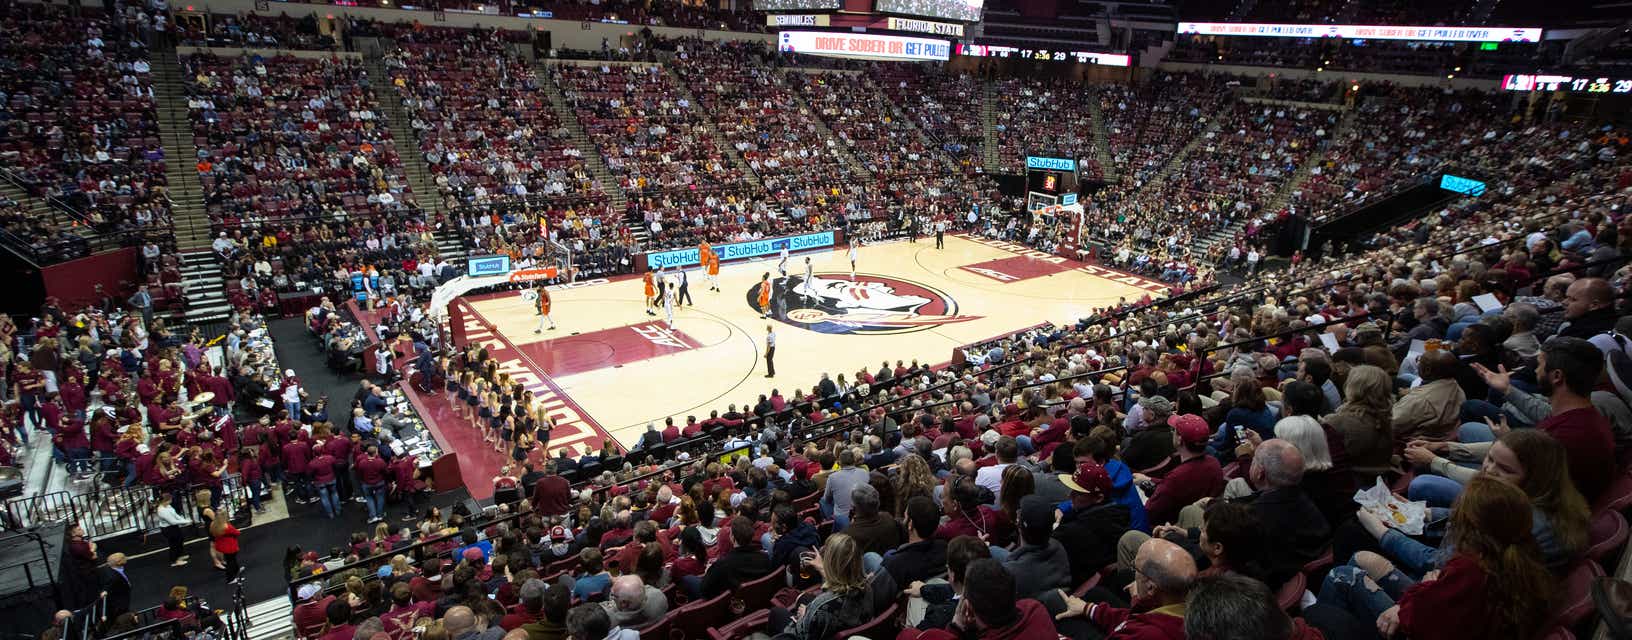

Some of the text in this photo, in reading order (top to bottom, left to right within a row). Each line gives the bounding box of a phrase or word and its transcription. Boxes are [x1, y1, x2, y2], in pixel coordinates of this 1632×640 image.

[896, 19, 932, 33] FLORIDA
[815, 37, 846, 50] DRIVE
[848, 38, 886, 53] SOBER
[888, 40, 903, 54] OR
[905, 41, 922, 55] GET
[1020, 49, 1033, 58] 17
[1053, 51, 1066, 61] 29
[1571, 79, 1589, 91] 17
[1613, 80, 1632, 92] 29
[1029, 157, 1070, 170] StubHub
[794, 235, 830, 248] StubHub
[728, 243, 769, 257] StubHub
[654, 251, 700, 267] StubHub
